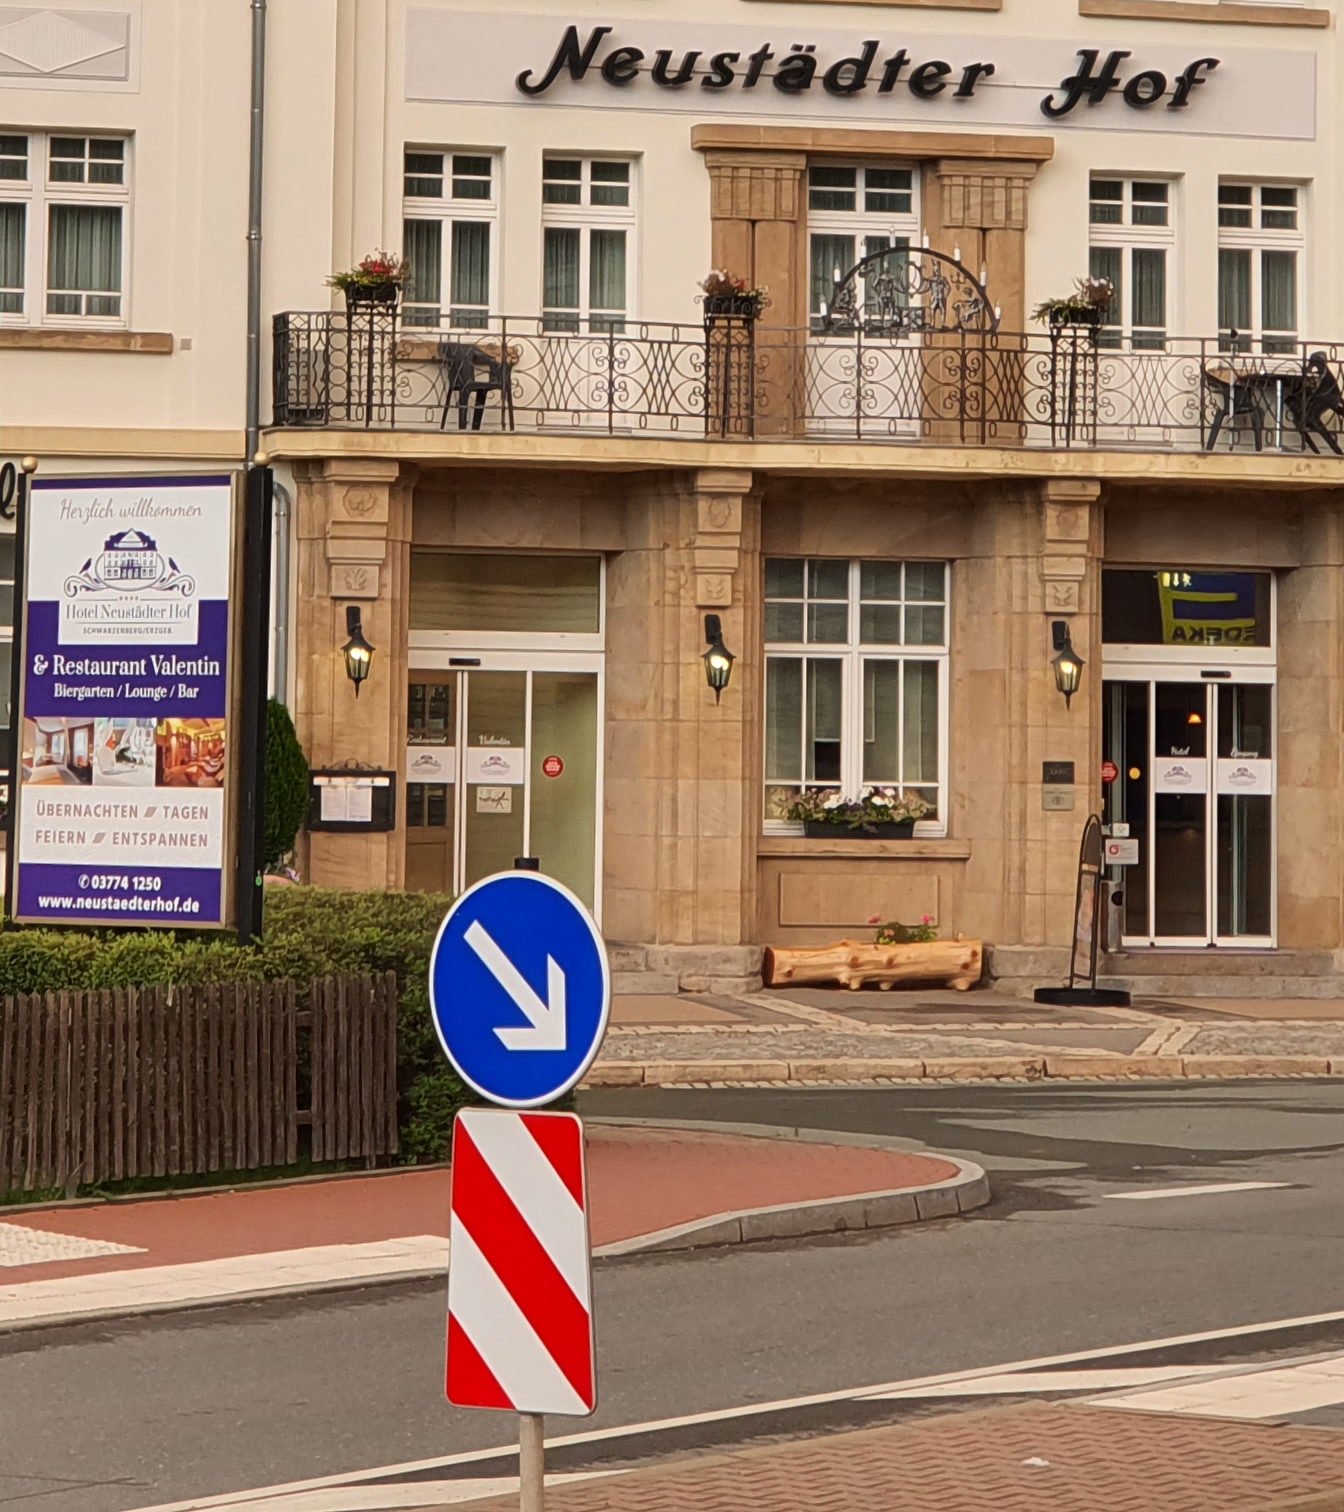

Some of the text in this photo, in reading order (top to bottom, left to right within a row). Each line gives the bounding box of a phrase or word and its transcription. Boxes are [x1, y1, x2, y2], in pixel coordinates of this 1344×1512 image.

[515, 24, 1220, 118] Neustädter Hof
[59, 497, 203, 525] Herzlich willkommen
[66, 603, 192, 619] Hotel Neustädter Hof
[33, 654, 220, 676] & Restaurant Valentin
[54, 683, 114, 701] Biergarten
[125, 683, 167, 701] Lounge
[178, 683, 199, 698] Bar
[36, 800, 209, 819] ÜBERNACHTEN TAGEN
[35, 830, 208, 847] FEIERN ENTSPANNEN
[91, 874, 162, 891] 03774 1250
[38, 894, 200, 913] www.neustaedterhof.de
